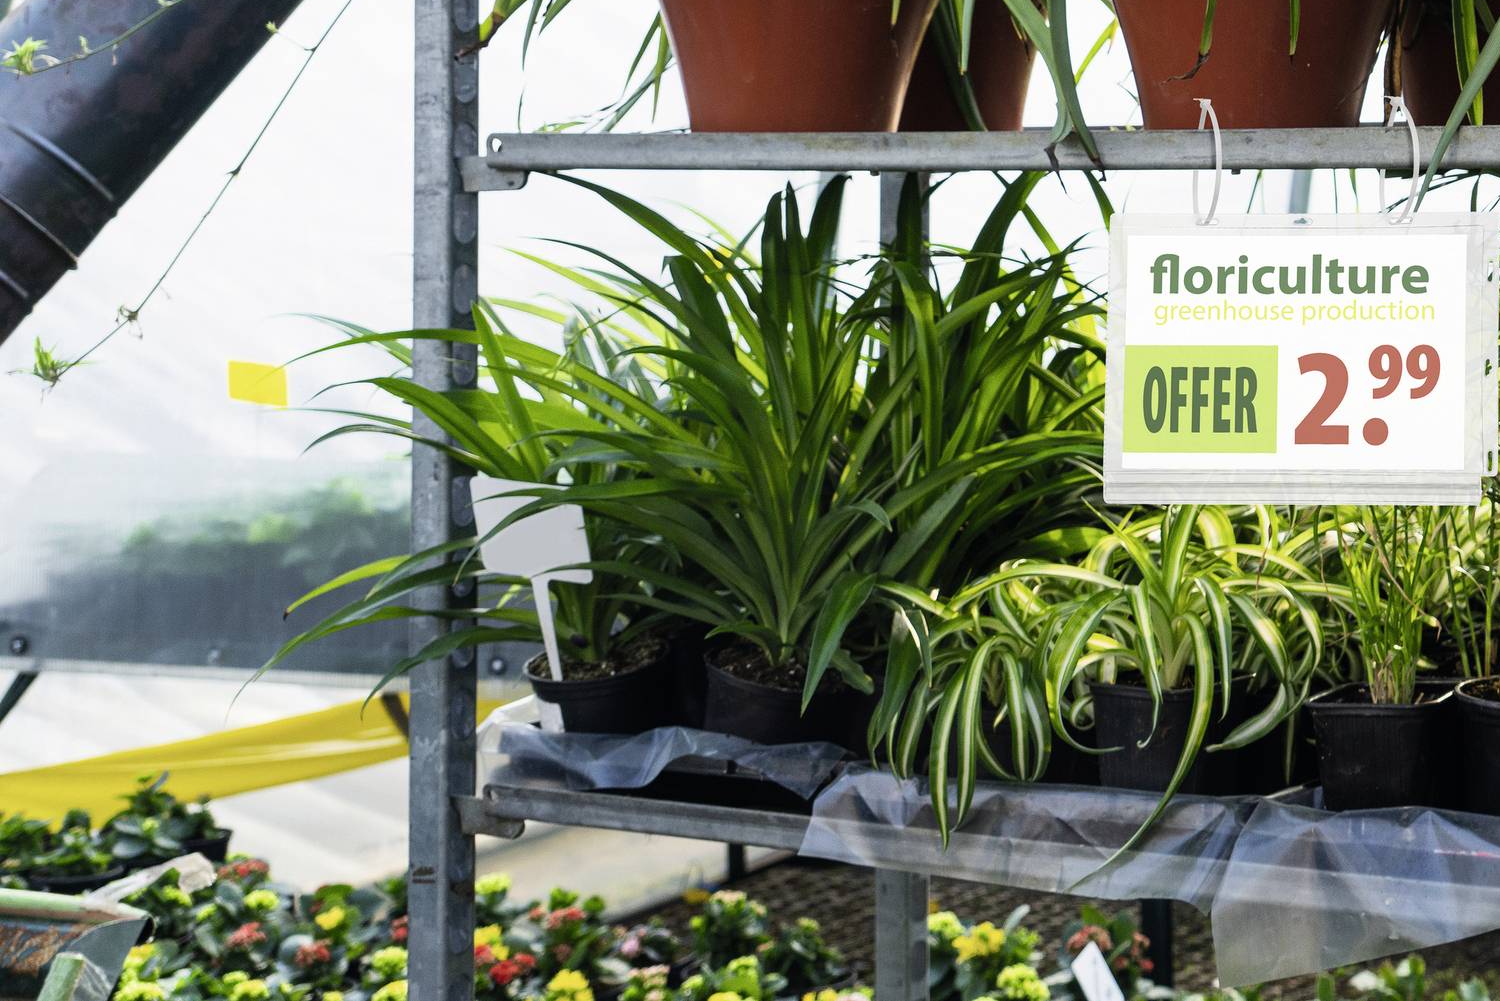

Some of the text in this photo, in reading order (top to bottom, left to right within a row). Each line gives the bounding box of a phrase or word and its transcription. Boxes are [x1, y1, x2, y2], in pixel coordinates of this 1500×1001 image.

[1150, 253, 1430, 295] floriculture
[1154, 299, 1435, 327] greenhouse production
[1143, 366, 1258, 433] OFFER
[1294, 344, 1441, 446] 2.99
